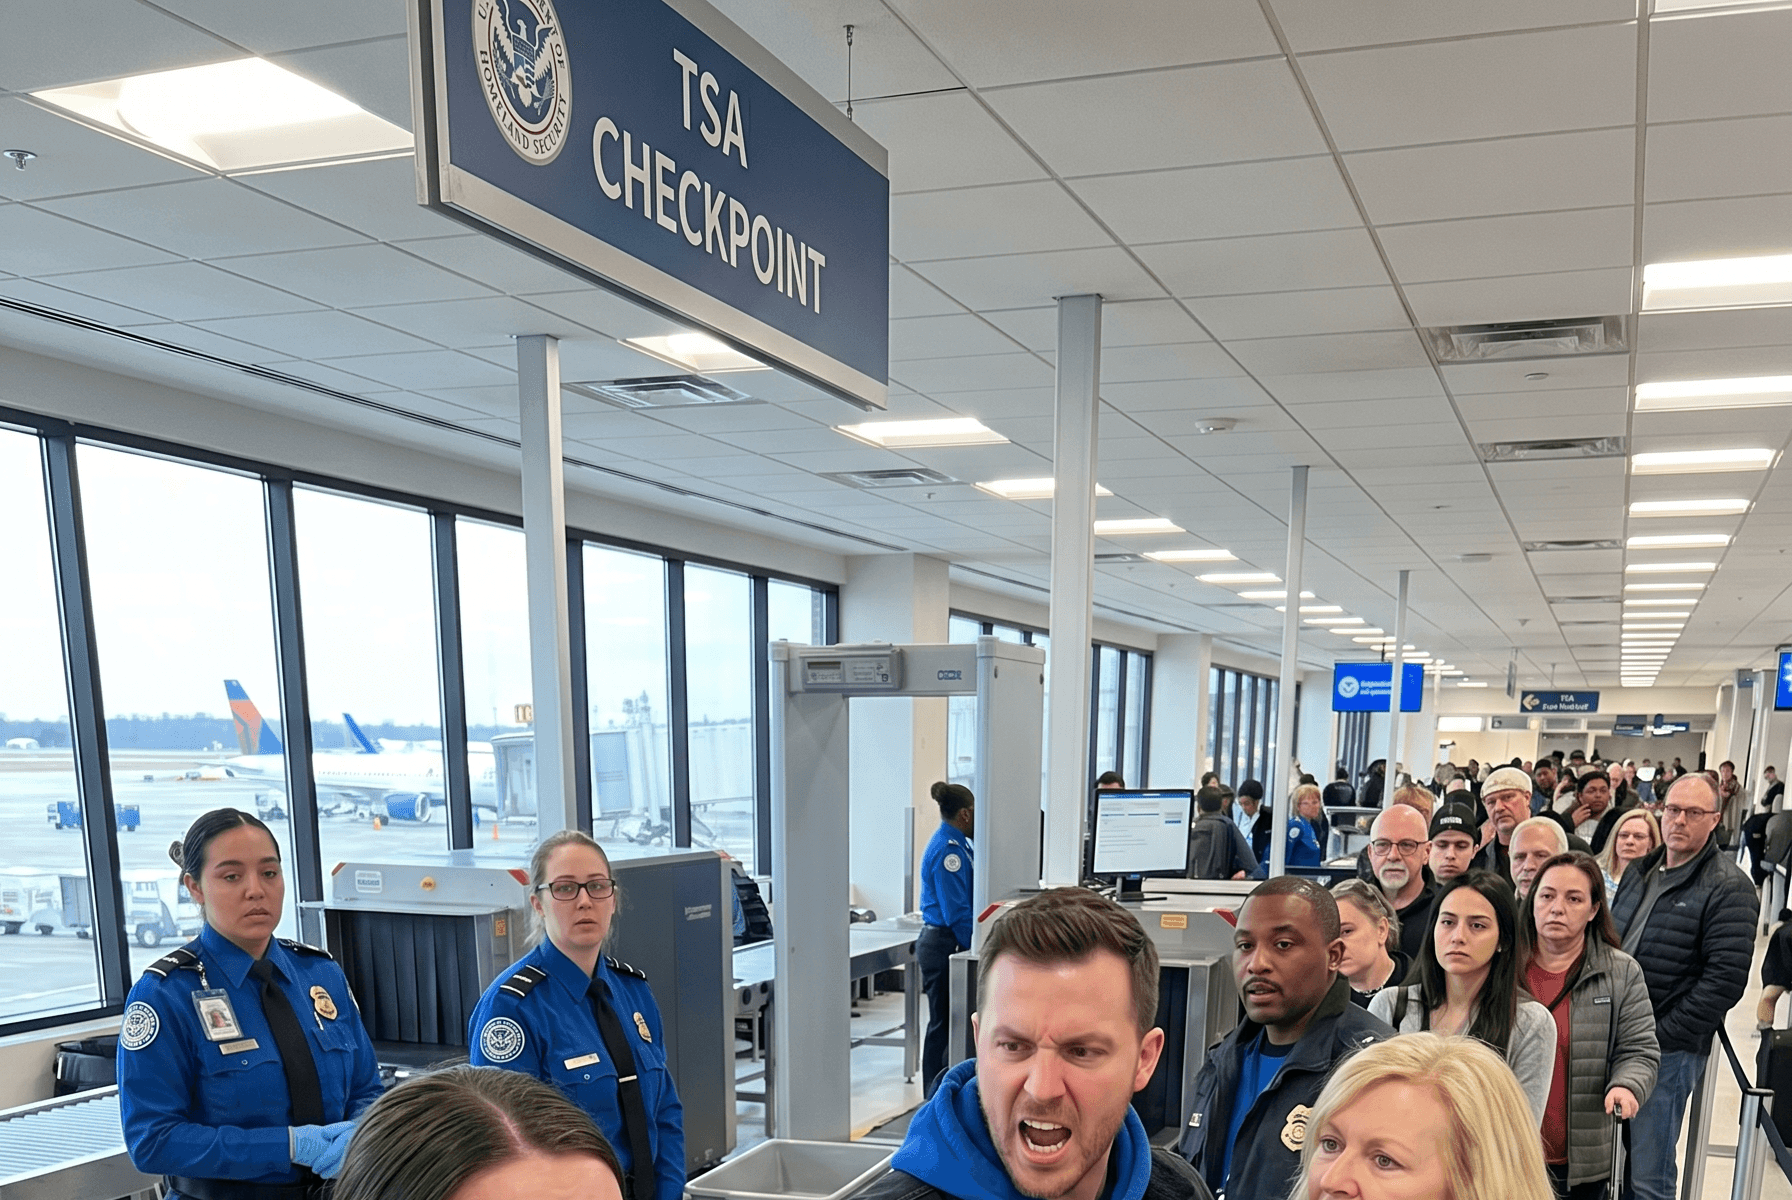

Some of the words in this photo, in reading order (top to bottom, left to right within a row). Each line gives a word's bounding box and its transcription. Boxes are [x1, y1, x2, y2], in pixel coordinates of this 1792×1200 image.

[480, 50, 529, 150] HOMELAND
[533, 93, 567, 155] SECURITY
[555, 43, 565, 70] OF
[673, 47, 748, 170] TSA
[592, 116, 826, 314] CHECKPOINT
